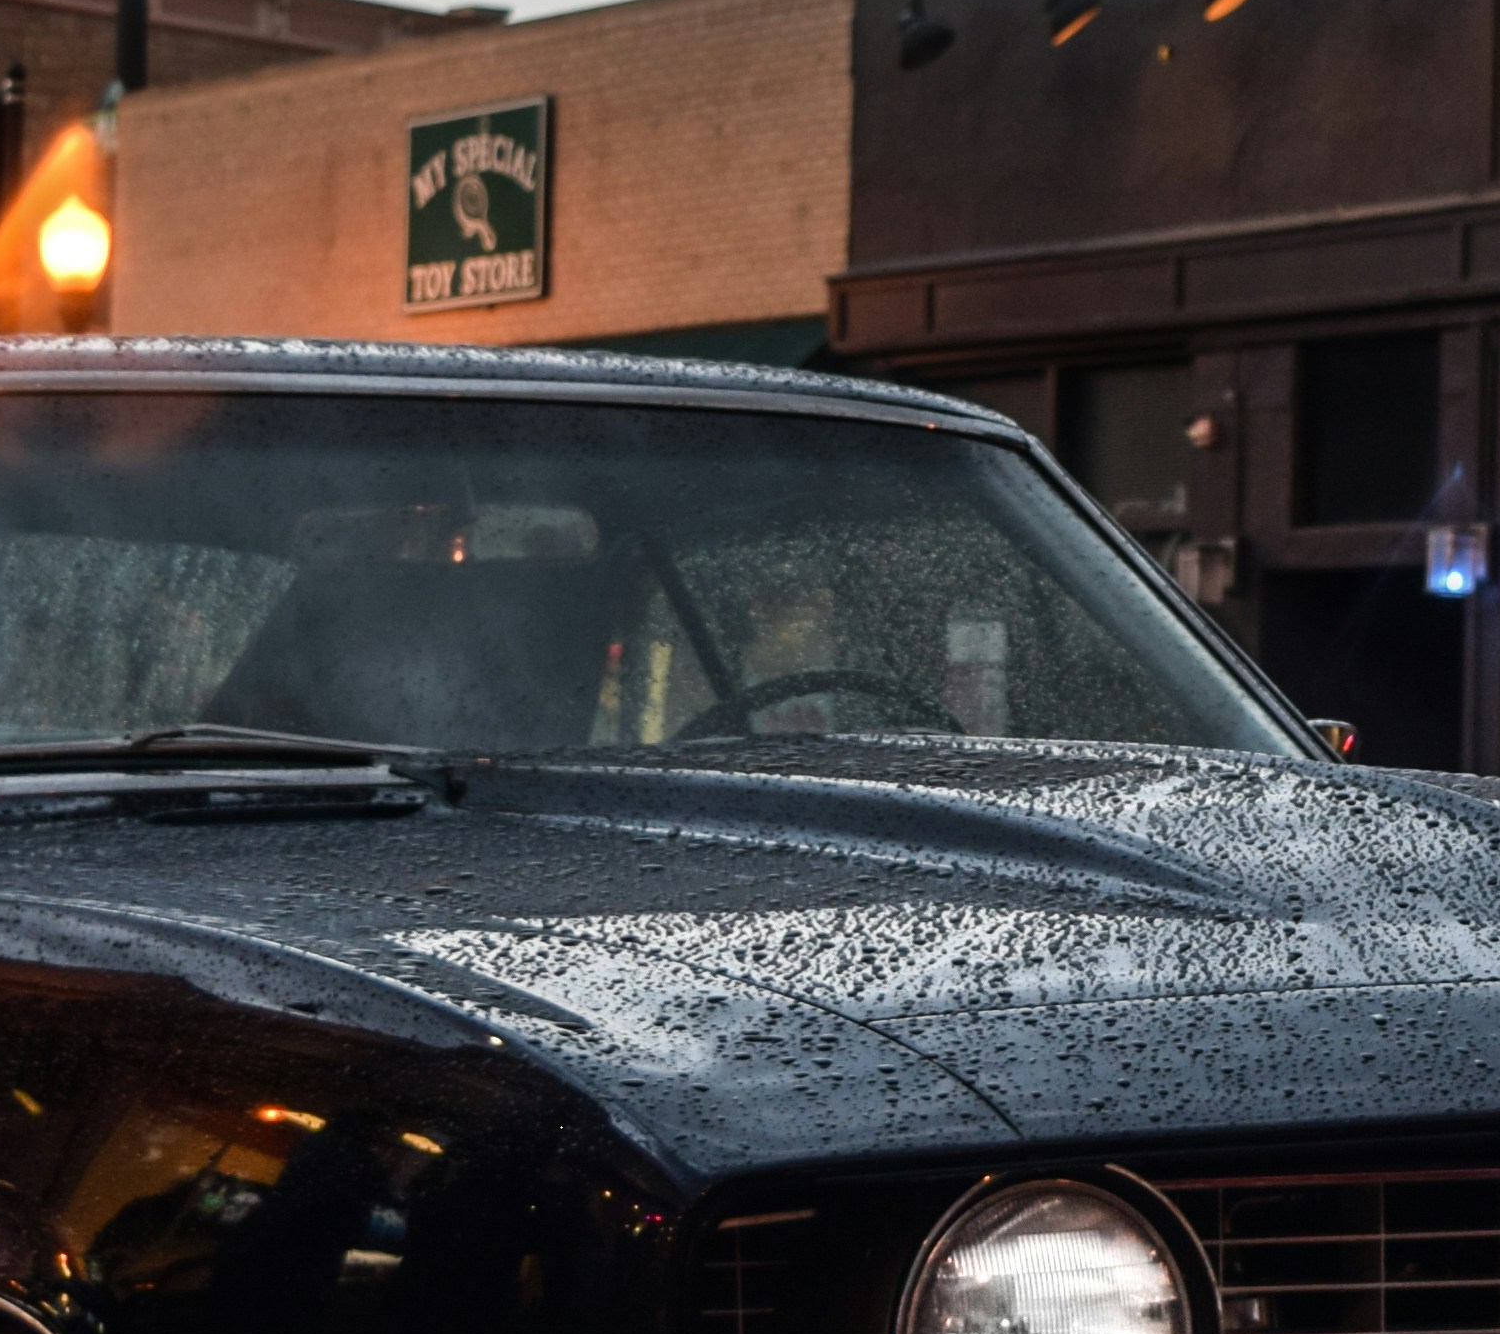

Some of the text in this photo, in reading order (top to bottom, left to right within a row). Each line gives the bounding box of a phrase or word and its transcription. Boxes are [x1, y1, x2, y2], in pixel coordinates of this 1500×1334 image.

[411, 132, 537, 210] MY SPECIAL
[410, 249, 535, 303] TOY STORE
